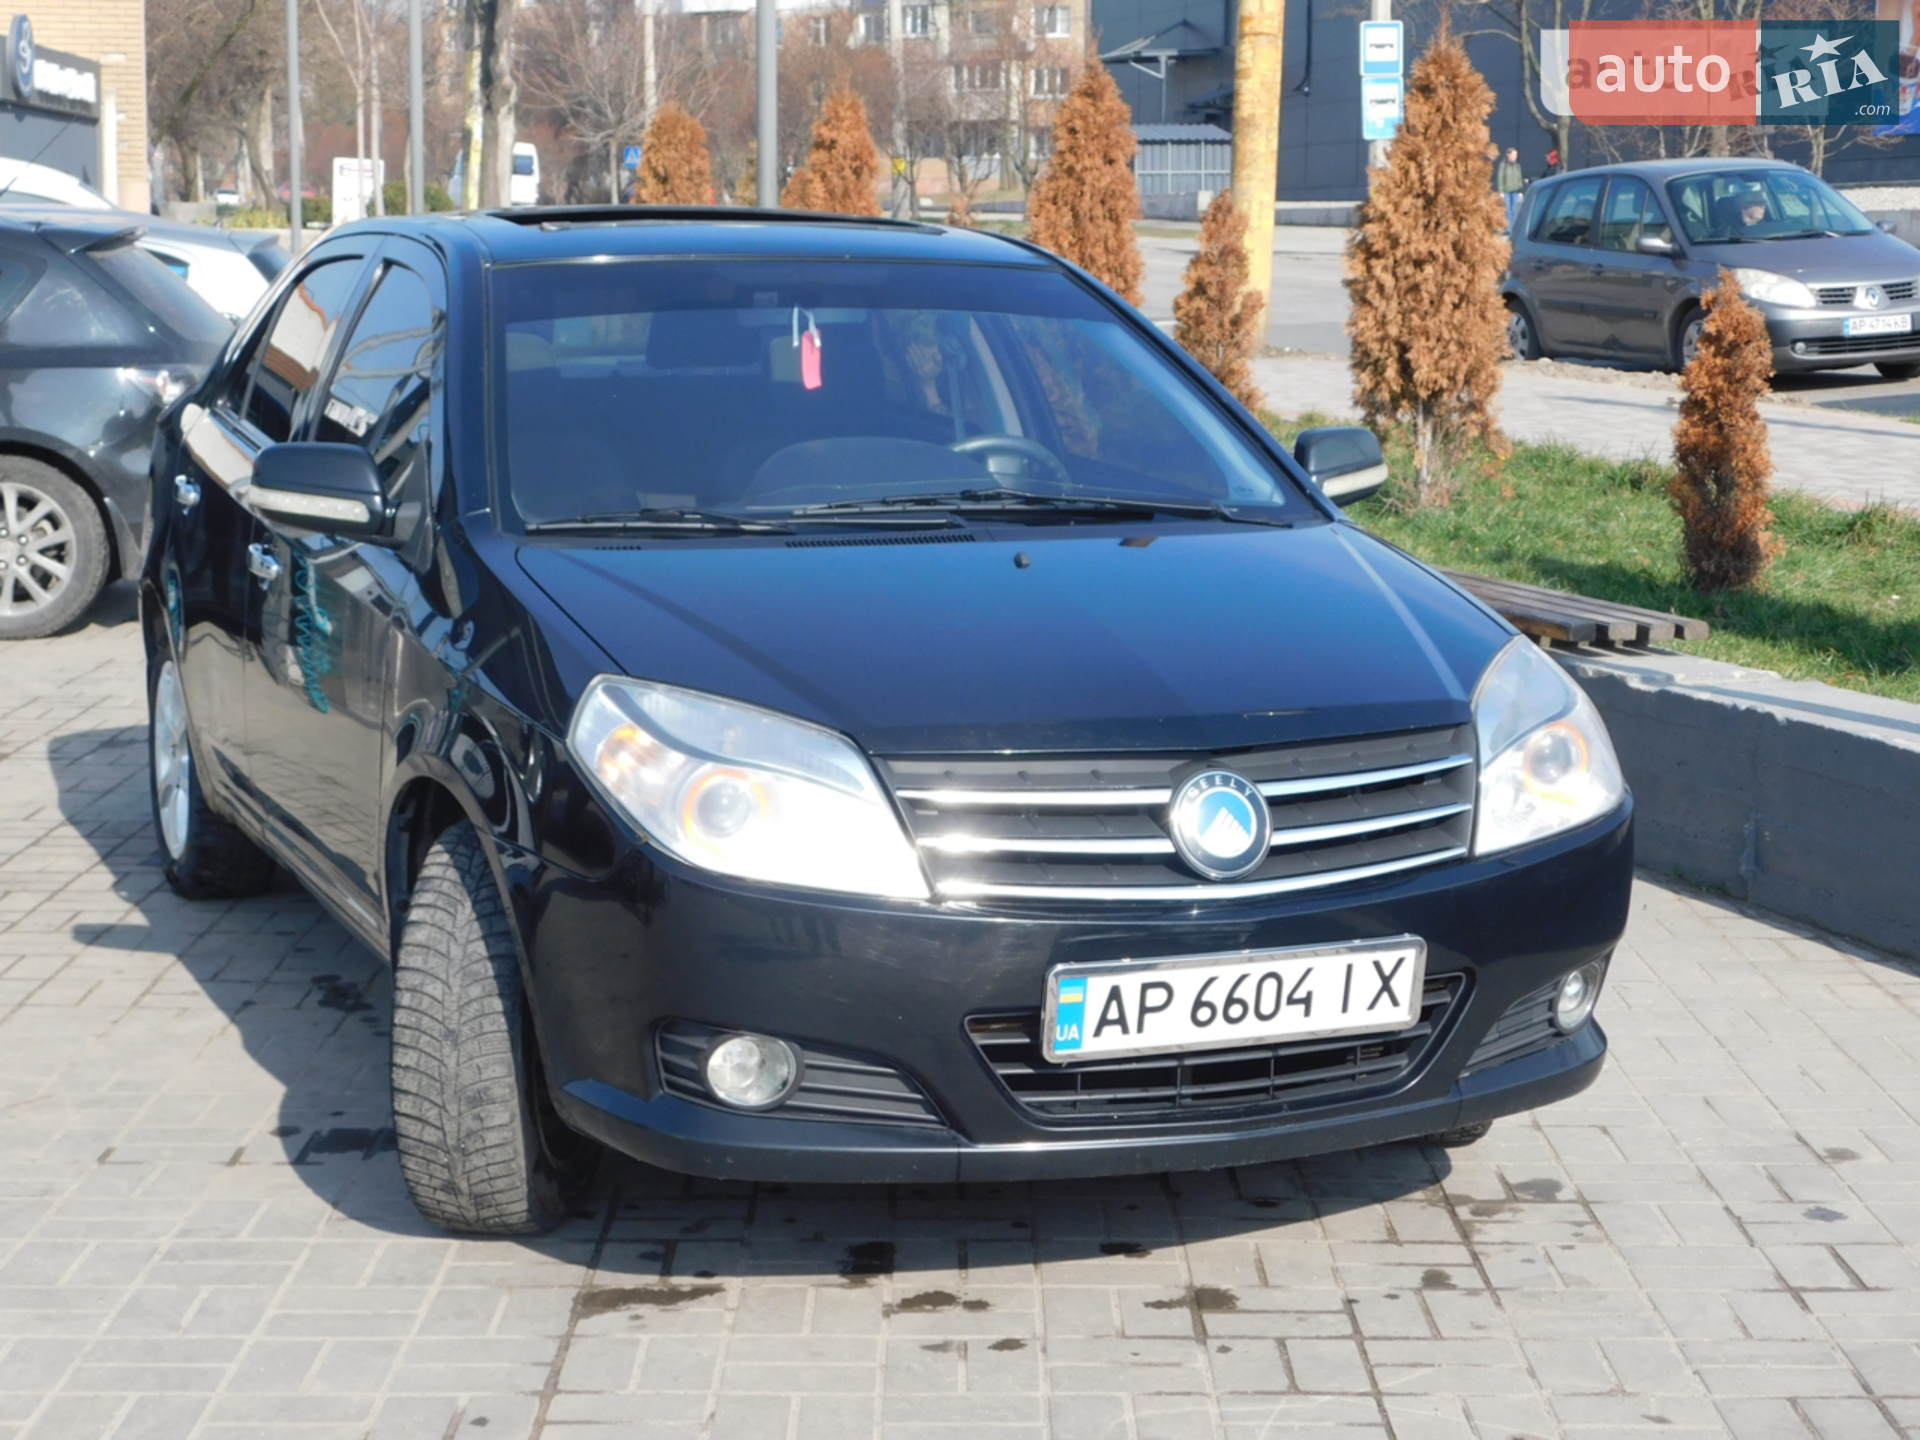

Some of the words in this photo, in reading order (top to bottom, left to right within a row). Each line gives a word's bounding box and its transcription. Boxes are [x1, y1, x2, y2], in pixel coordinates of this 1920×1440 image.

[1186, 774, 1254, 798] GEELY
[1092, 980, 1175, 1038] AP
[1189, 967, 1315, 1028] 6604
[1055, 1023, 1081, 1042] UA
